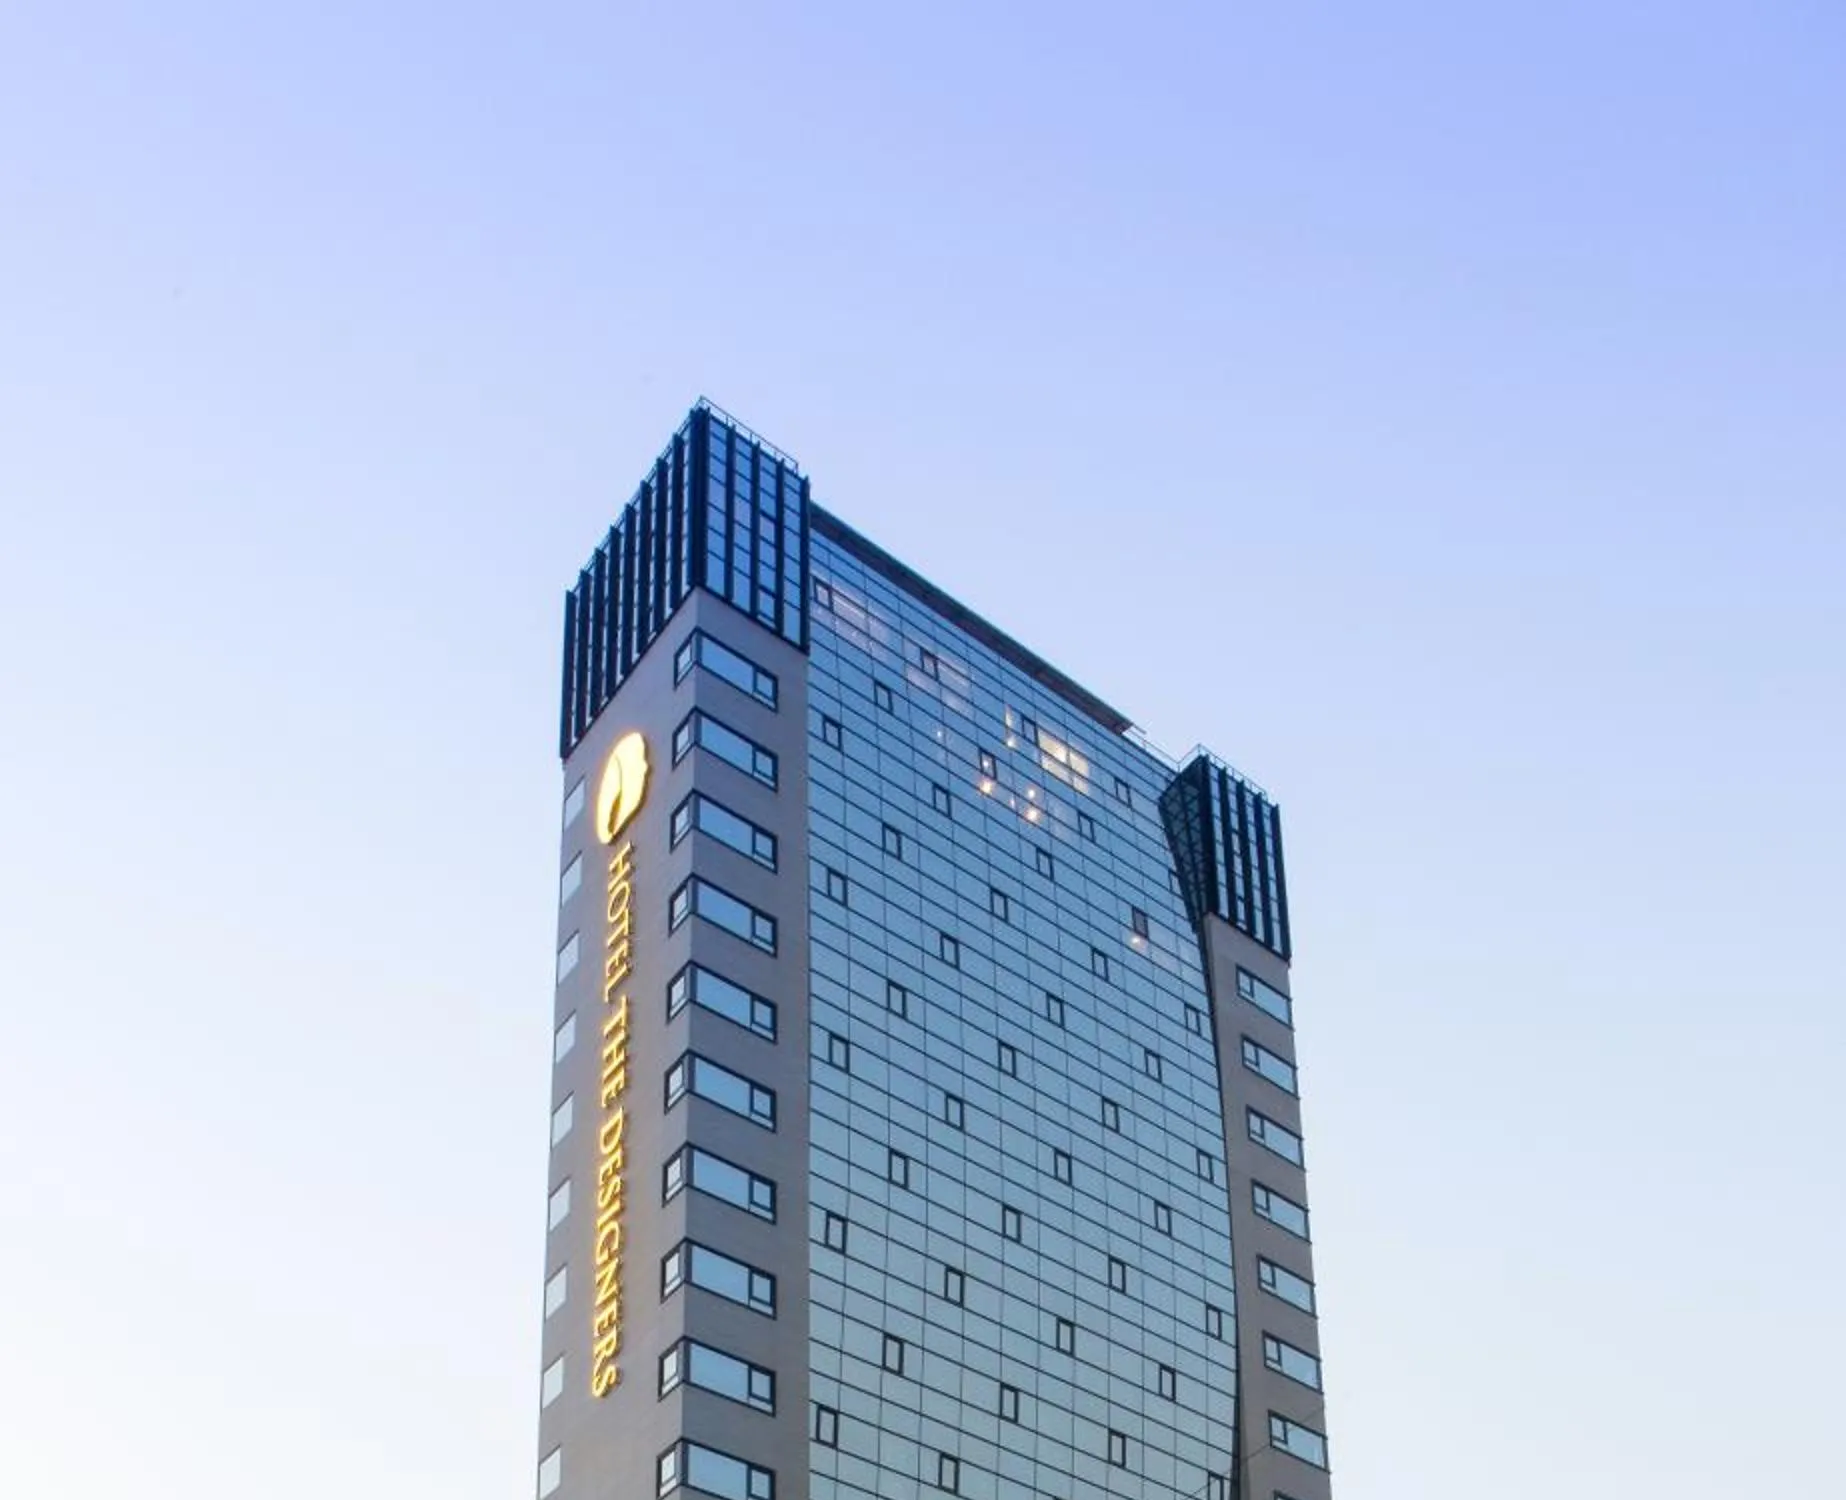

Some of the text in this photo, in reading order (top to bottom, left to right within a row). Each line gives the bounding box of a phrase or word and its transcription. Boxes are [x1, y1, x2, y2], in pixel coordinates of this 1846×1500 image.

[590, 842, 638, 1400] HOTEL THE DESIGNERS
